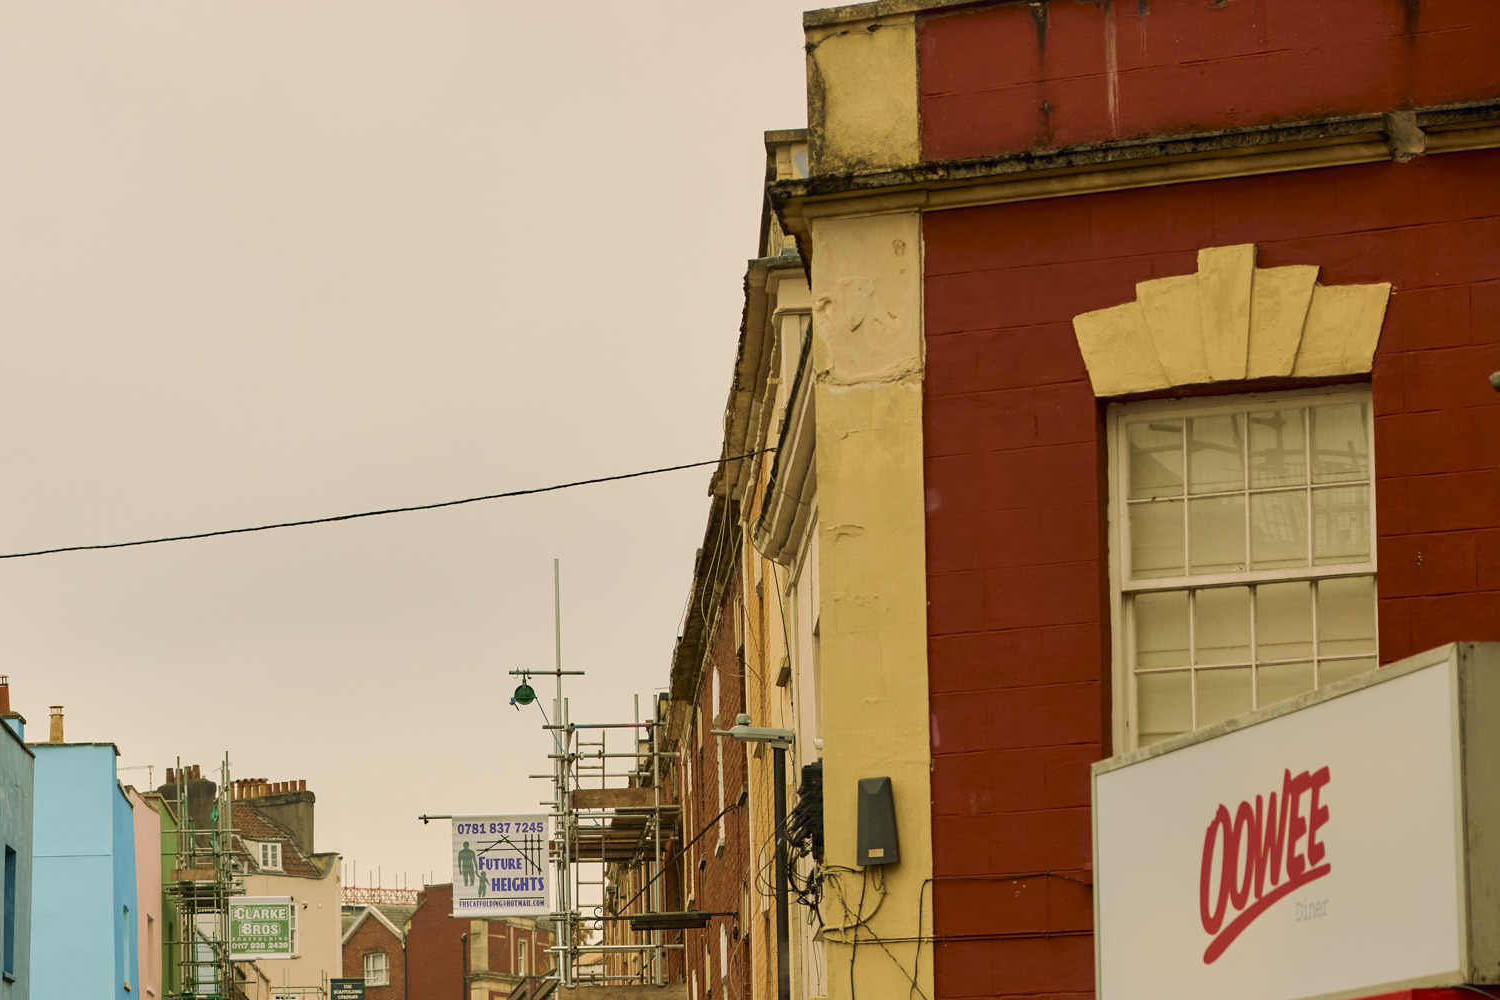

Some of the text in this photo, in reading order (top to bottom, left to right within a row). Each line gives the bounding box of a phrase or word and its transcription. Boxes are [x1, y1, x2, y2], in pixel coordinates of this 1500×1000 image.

[457, 821, 544, 835] 0781 837 7245
[1199, 765, 1332, 937] OOWEE
[478, 856, 523, 871] FUTURE
[491, 876, 545, 892] HEIGHTS
[233, 906, 287, 920] CLARKE
[1295, 898, 1329, 923] Diner
[241, 923, 280, 936] BROS
